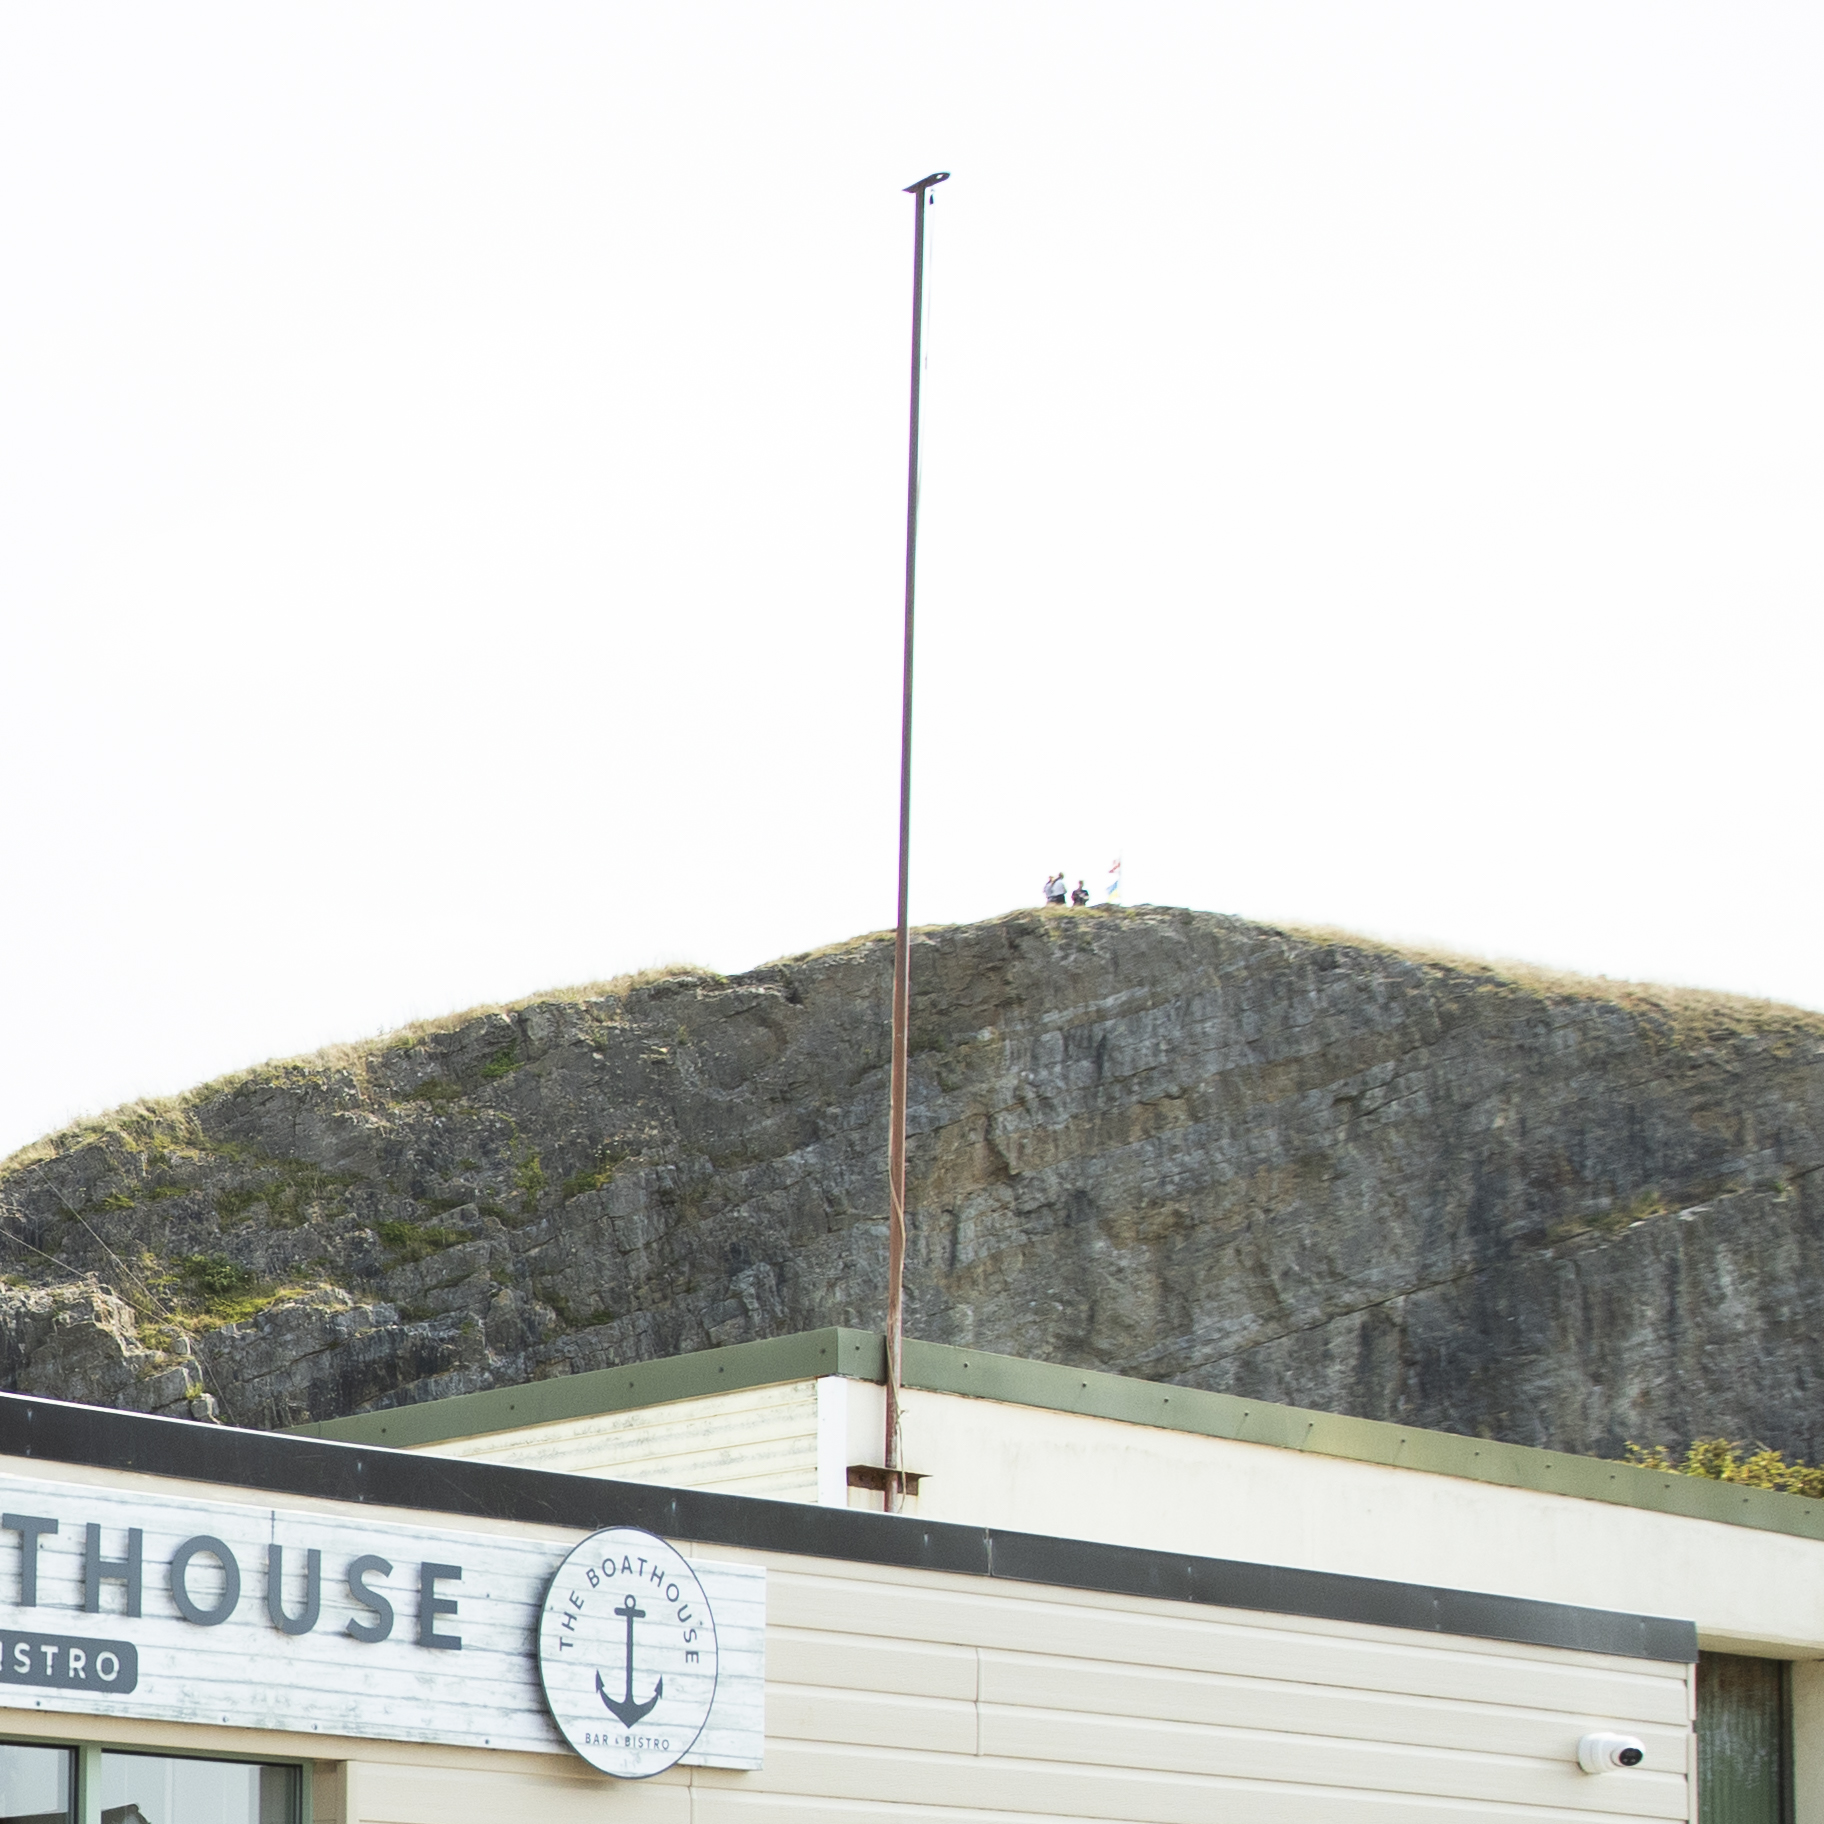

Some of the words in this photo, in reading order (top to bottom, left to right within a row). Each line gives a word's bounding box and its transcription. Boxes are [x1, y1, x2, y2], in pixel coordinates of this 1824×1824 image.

[559, 1590, 585, 1651] THE
[585, 1555, 699, 1664] BOATHOUSE
[585, 1732, 609, 1745] BAR
[625, 1735, 670, 1750] BISTRO
